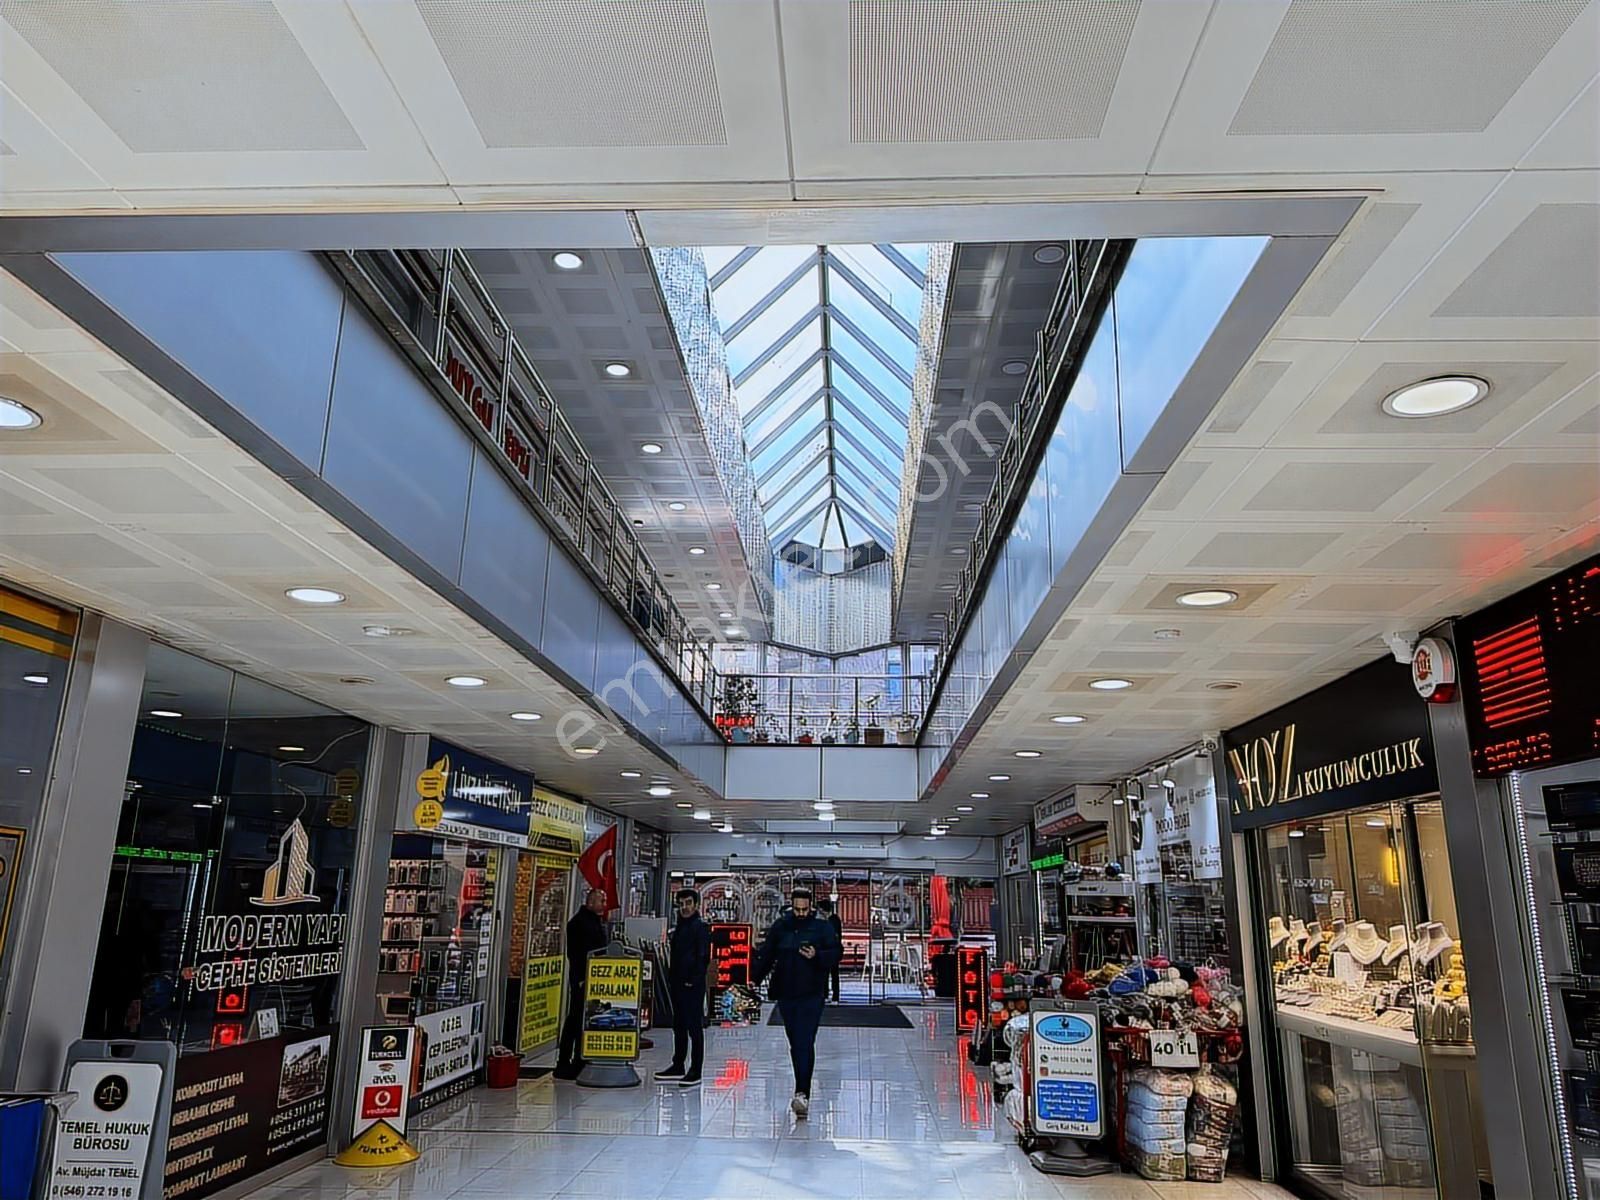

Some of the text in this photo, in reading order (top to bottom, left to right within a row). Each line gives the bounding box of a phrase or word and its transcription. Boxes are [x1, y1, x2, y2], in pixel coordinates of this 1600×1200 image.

[1304, 737, 1425, 796] KUYUMCULUK
[200, 914, 347, 952] MODERN YAPI
[196, 947, 343, 991] CEPHE SİSTEMLERİ
[591, 965, 638, 981] GEZZ ARAÇ
[1153, 1042, 1174, 1055] 40
[372, 1074, 397, 1084] avea
[60, 1121, 150, 1135] TEMEL HUKUK
[73, 1135, 130, 1150] BÜROSU
[55, 1166, 140, 1178] Av. Müjdat TEMEL
[87, 1185, 106, 1197] 272
[108, 1186, 119, 1197] 19
